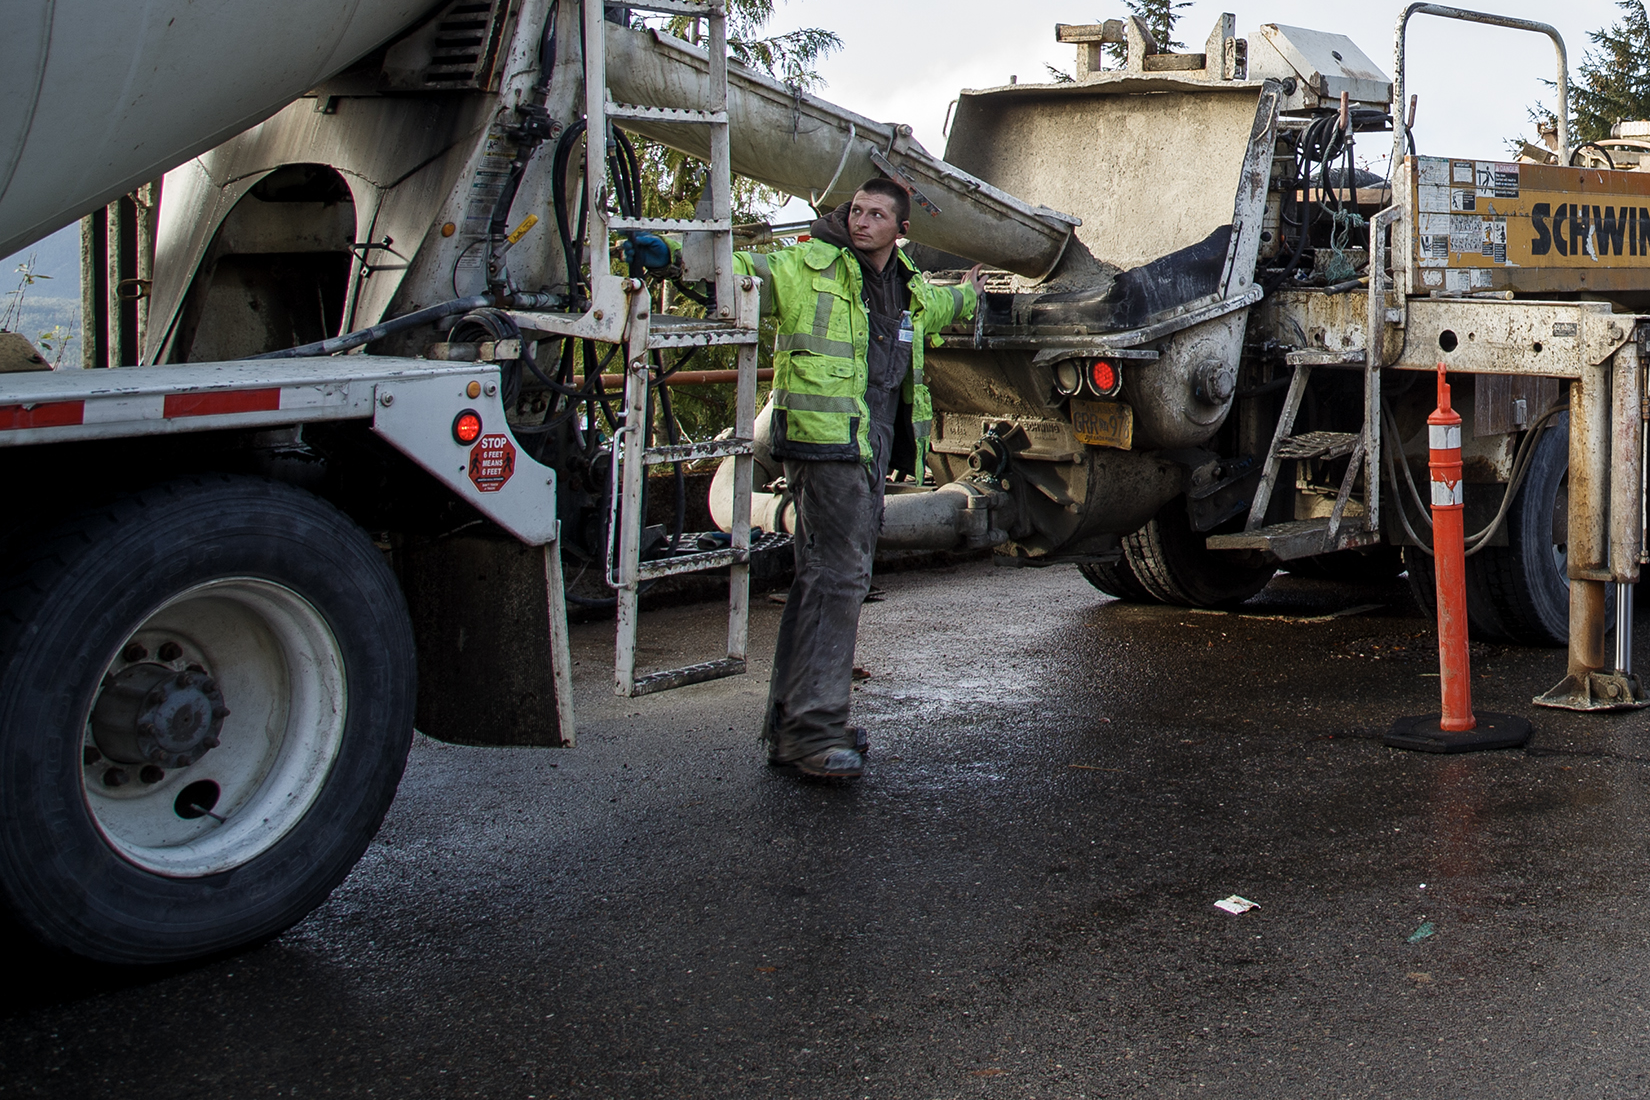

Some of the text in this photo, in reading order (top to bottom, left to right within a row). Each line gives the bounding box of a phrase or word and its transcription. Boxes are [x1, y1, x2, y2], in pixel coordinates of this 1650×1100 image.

[1073, 411, 1098, 435] GRR
[481, 437, 507, 449] STOP
[482, 459, 503, 467] MEANS
[487, 467, 502, 475] FEET
